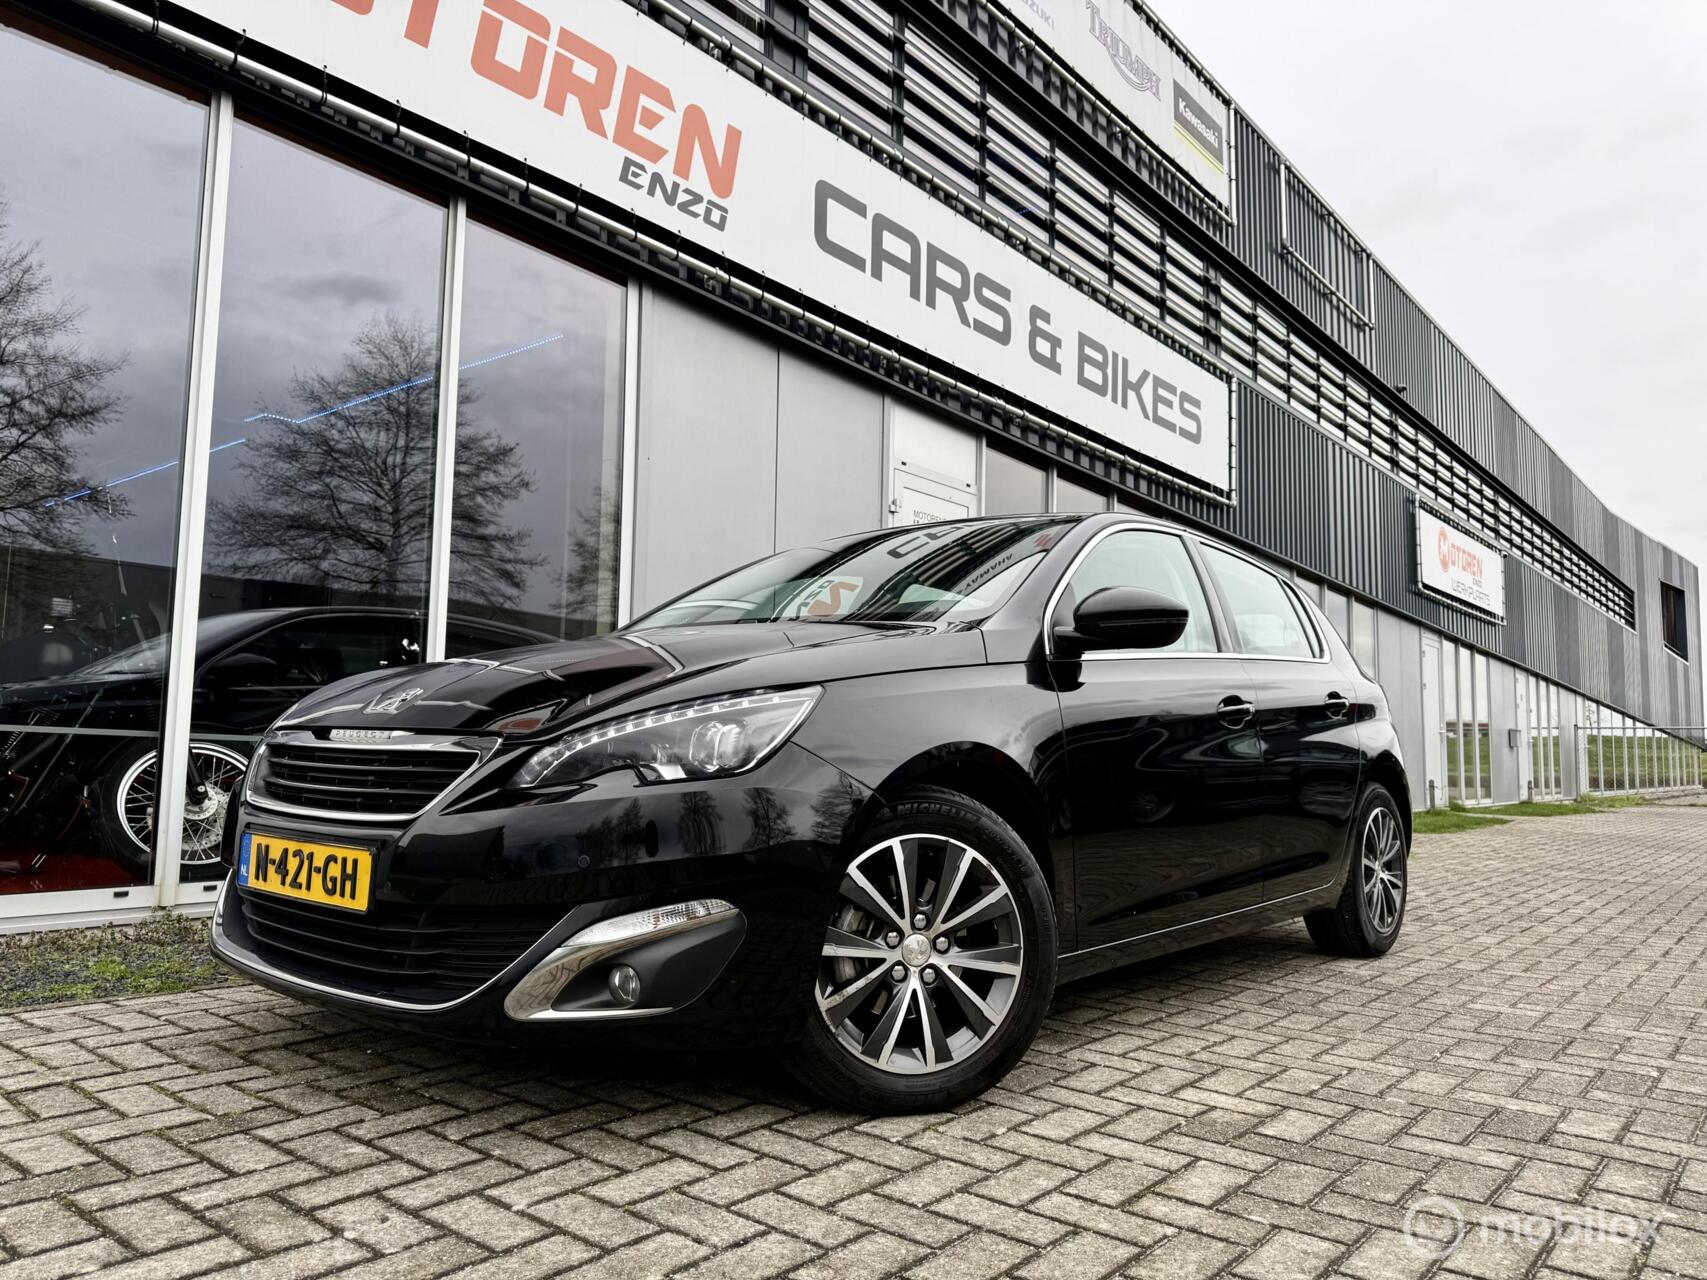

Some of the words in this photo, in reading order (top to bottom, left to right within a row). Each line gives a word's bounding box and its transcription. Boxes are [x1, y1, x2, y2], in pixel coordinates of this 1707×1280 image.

[1086, 0, 1161, 101] TRIUMPH
[1178, 98, 1219, 149] Kawasaki
[619, 156, 729, 232] ENZO
[814, 179, 1012, 347] CARS
[1028, 304, 1062, 376] &
[1077, 330, 1202, 445] BIKES
[1438, 529, 1483, 580] MOTOREN
[335, 730, 385, 739] PEUGEOT
[897, 802, 979, 823] MICHELIN
[240, 863, 248, 877] NL
[254, 842, 359, 901] N-421-GH
